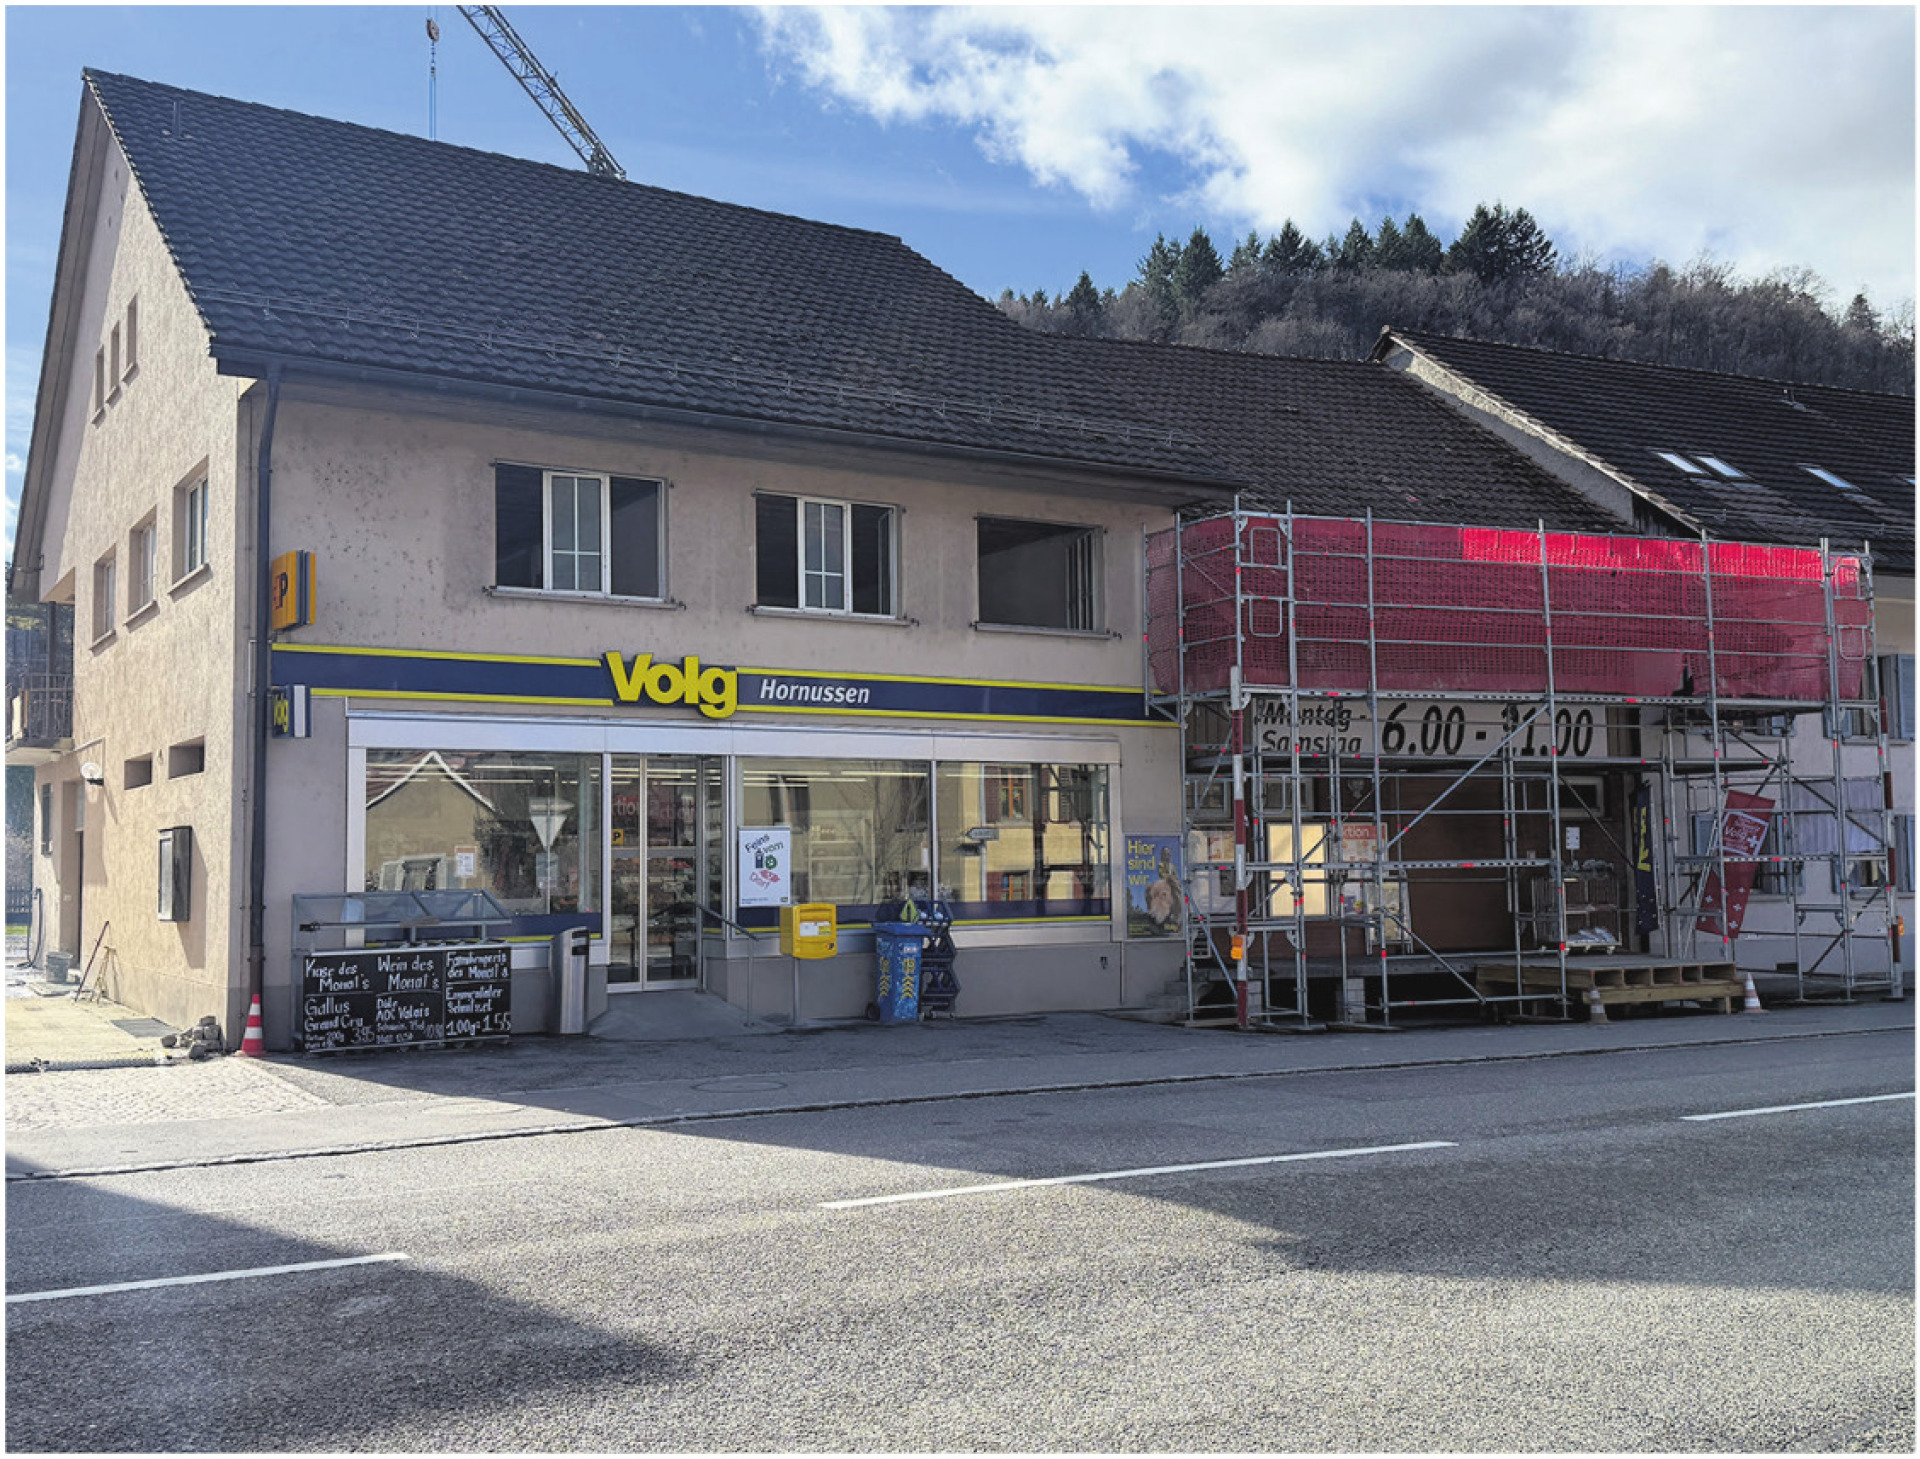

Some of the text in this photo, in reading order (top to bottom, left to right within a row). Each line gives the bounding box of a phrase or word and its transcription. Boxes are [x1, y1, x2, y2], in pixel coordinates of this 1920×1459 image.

[606, 651, 870, 718] Volg Hornussen
[1262, 701, 1352, 732] Mntag
[1382, 702, 1465, 755] 6.00
[1261, 729, 1362, 752] Samsag
[763, 842, 784, 853] vom
[1128, 839, 1156, 855] Hier
[1128, 856, 1156, 871] sind
[1128, 871, 1150, 885] wir
[338, 961, 358, 975] des
[377, 954, 435, 973] Wein des
[447, 965, 465, 979] des
[304, 996, 351, 1016] Gallus
[398, 1001, 430, 1019] Valais
[304, 1013, 364, 1033] Grand Cru
